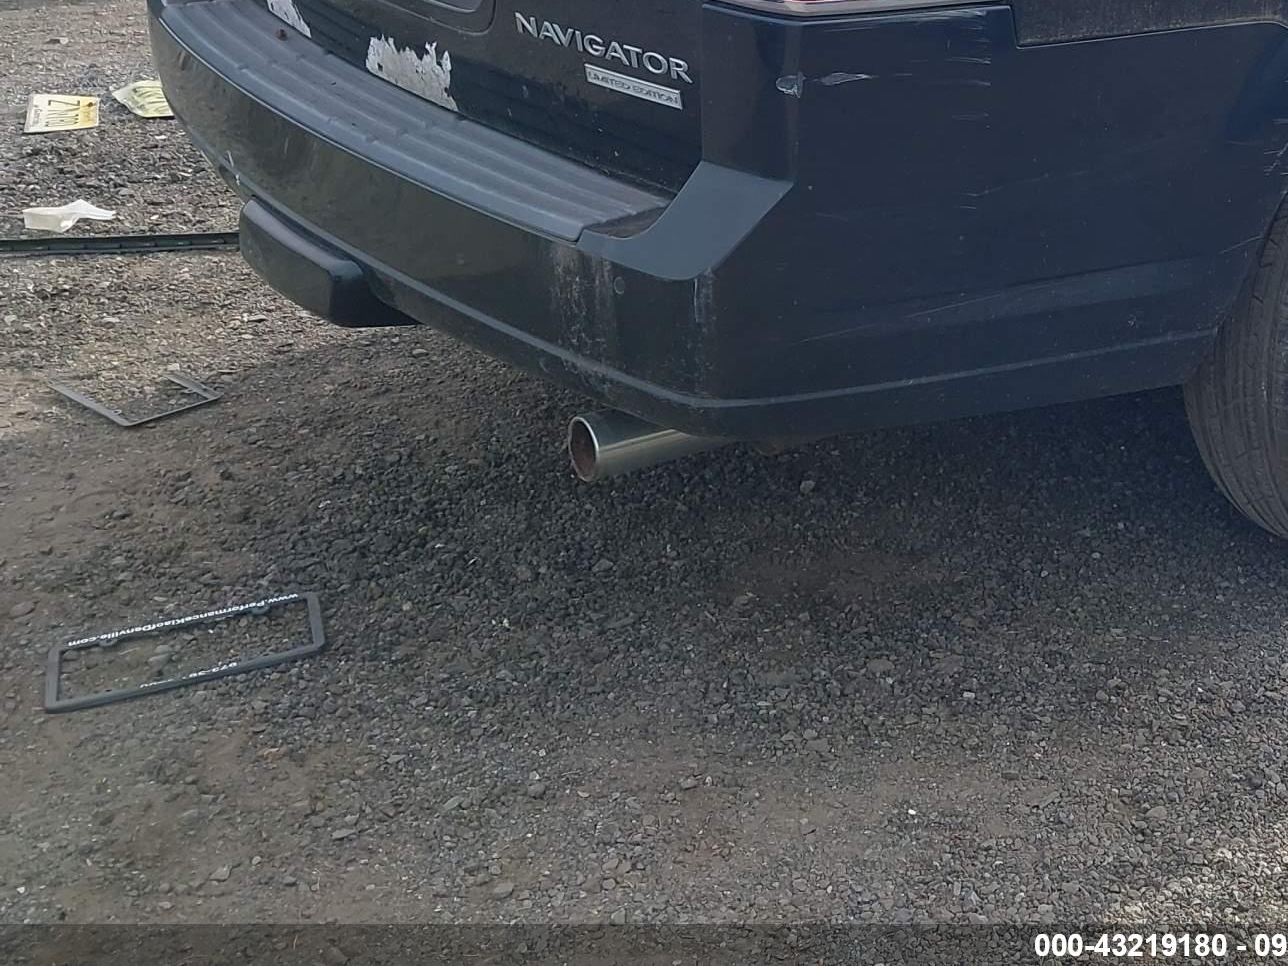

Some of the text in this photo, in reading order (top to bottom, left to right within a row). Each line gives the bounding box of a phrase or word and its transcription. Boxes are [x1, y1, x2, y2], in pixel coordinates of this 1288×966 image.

[514, 11, 693, 84] NAVIGATOR
[587, 71, 679, 104] LIMITED EDITION
